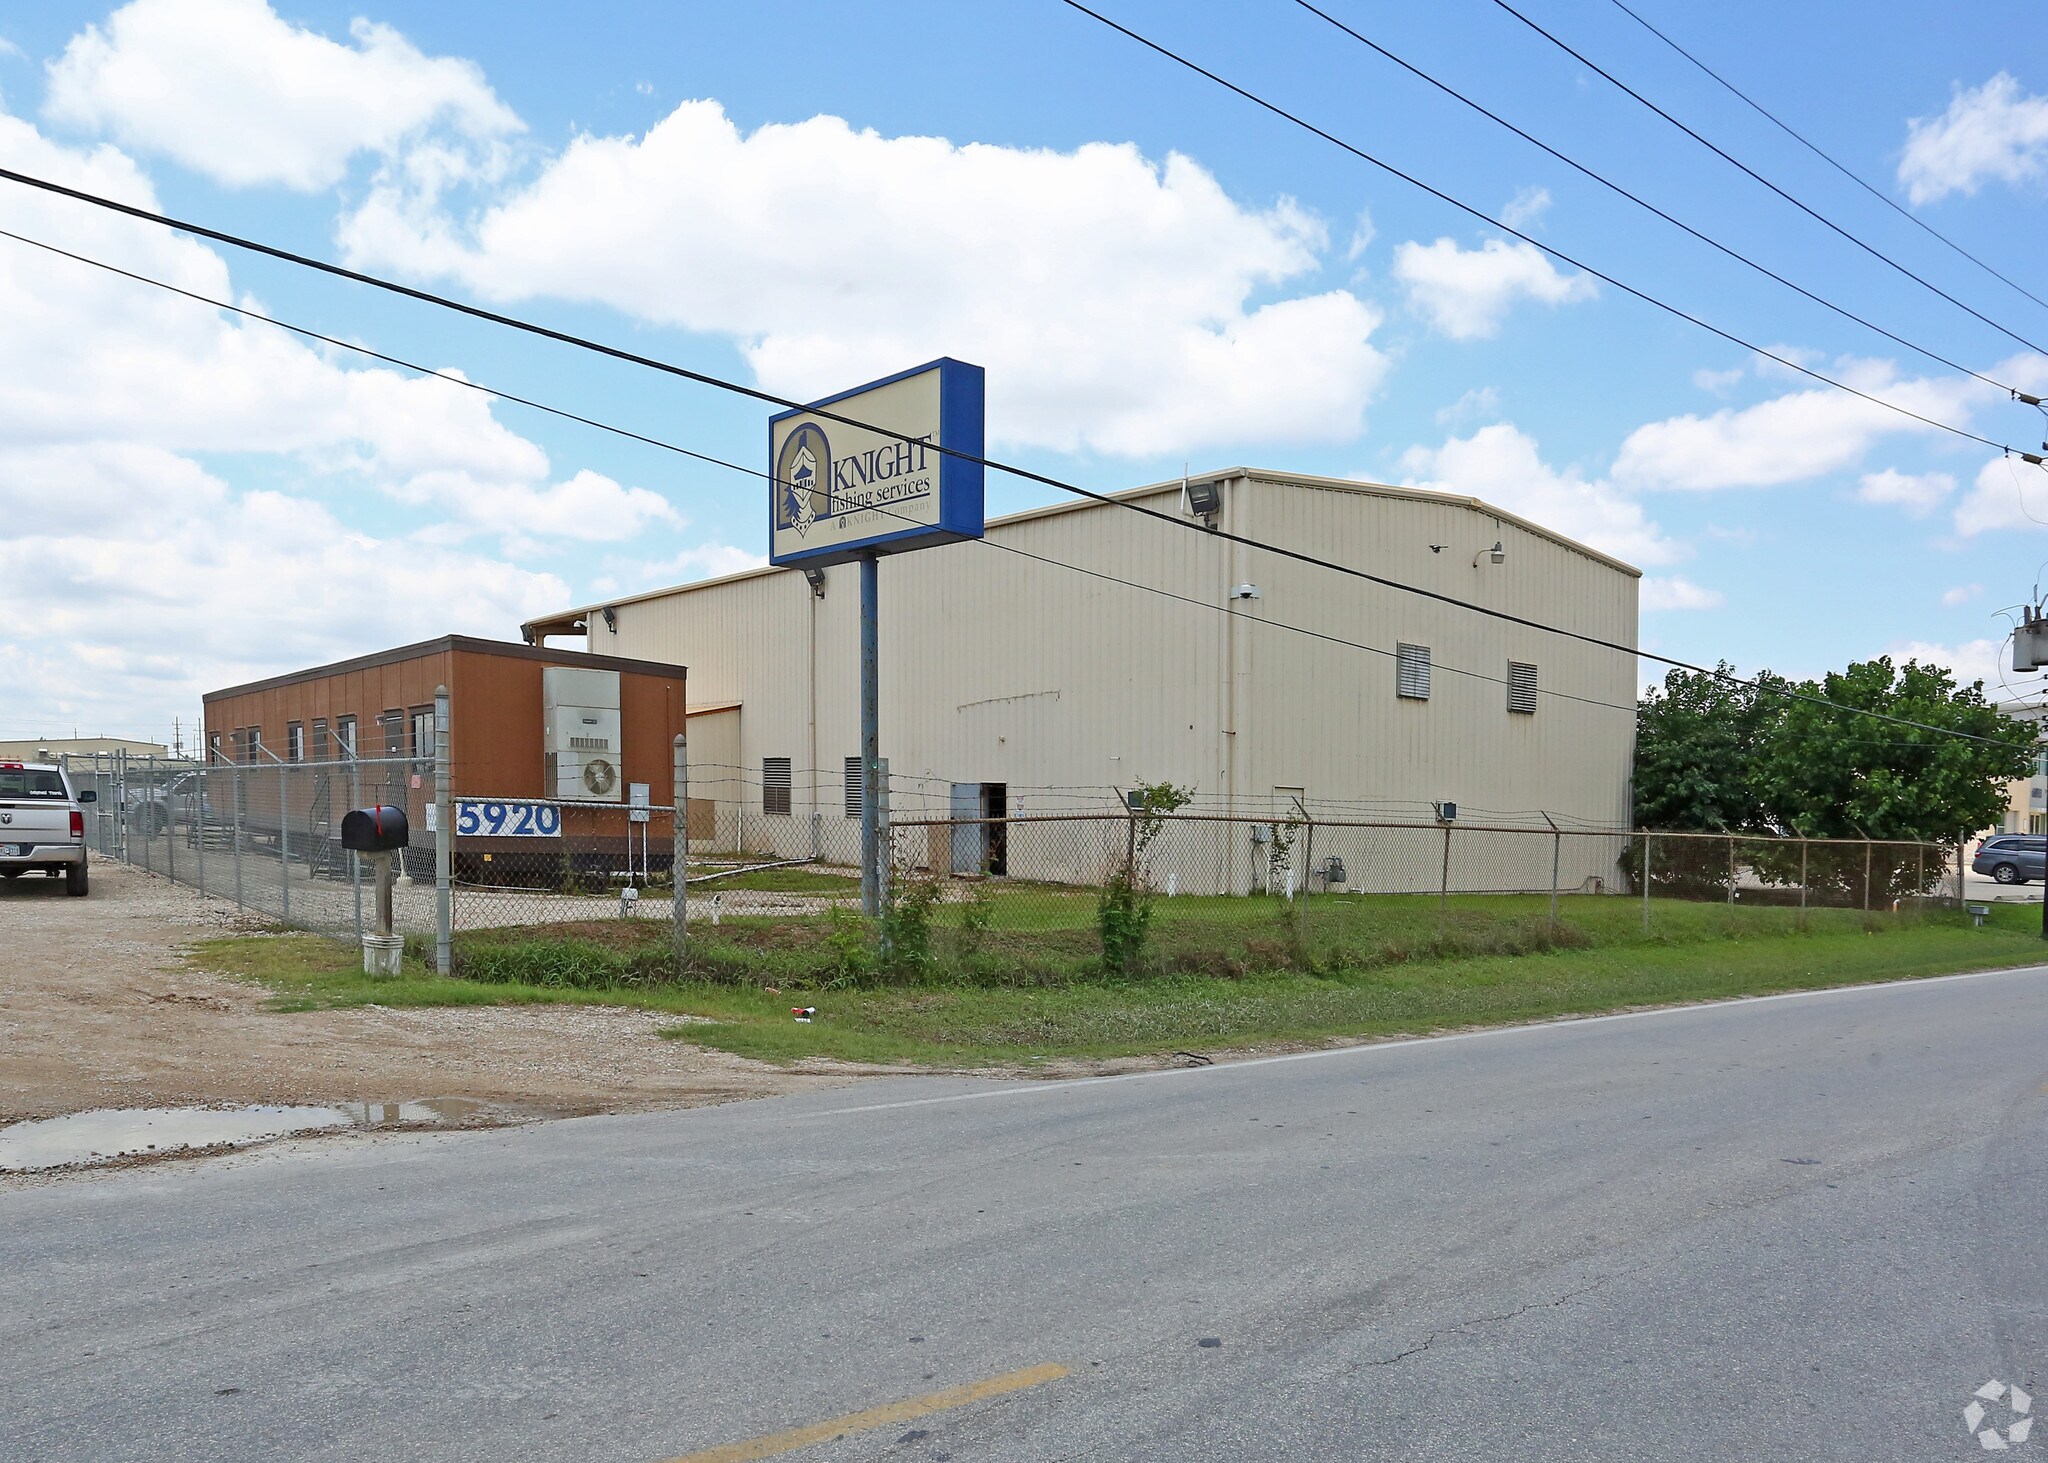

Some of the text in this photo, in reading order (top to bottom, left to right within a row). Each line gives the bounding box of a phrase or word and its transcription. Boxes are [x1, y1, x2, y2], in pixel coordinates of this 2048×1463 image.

[832, 434, 932, 493] KNIGHT
[832, 476, 931, 513] fishing services
[847, 508, 887, 528] KNIGHT
[458, 802, 560, 834] 5920
